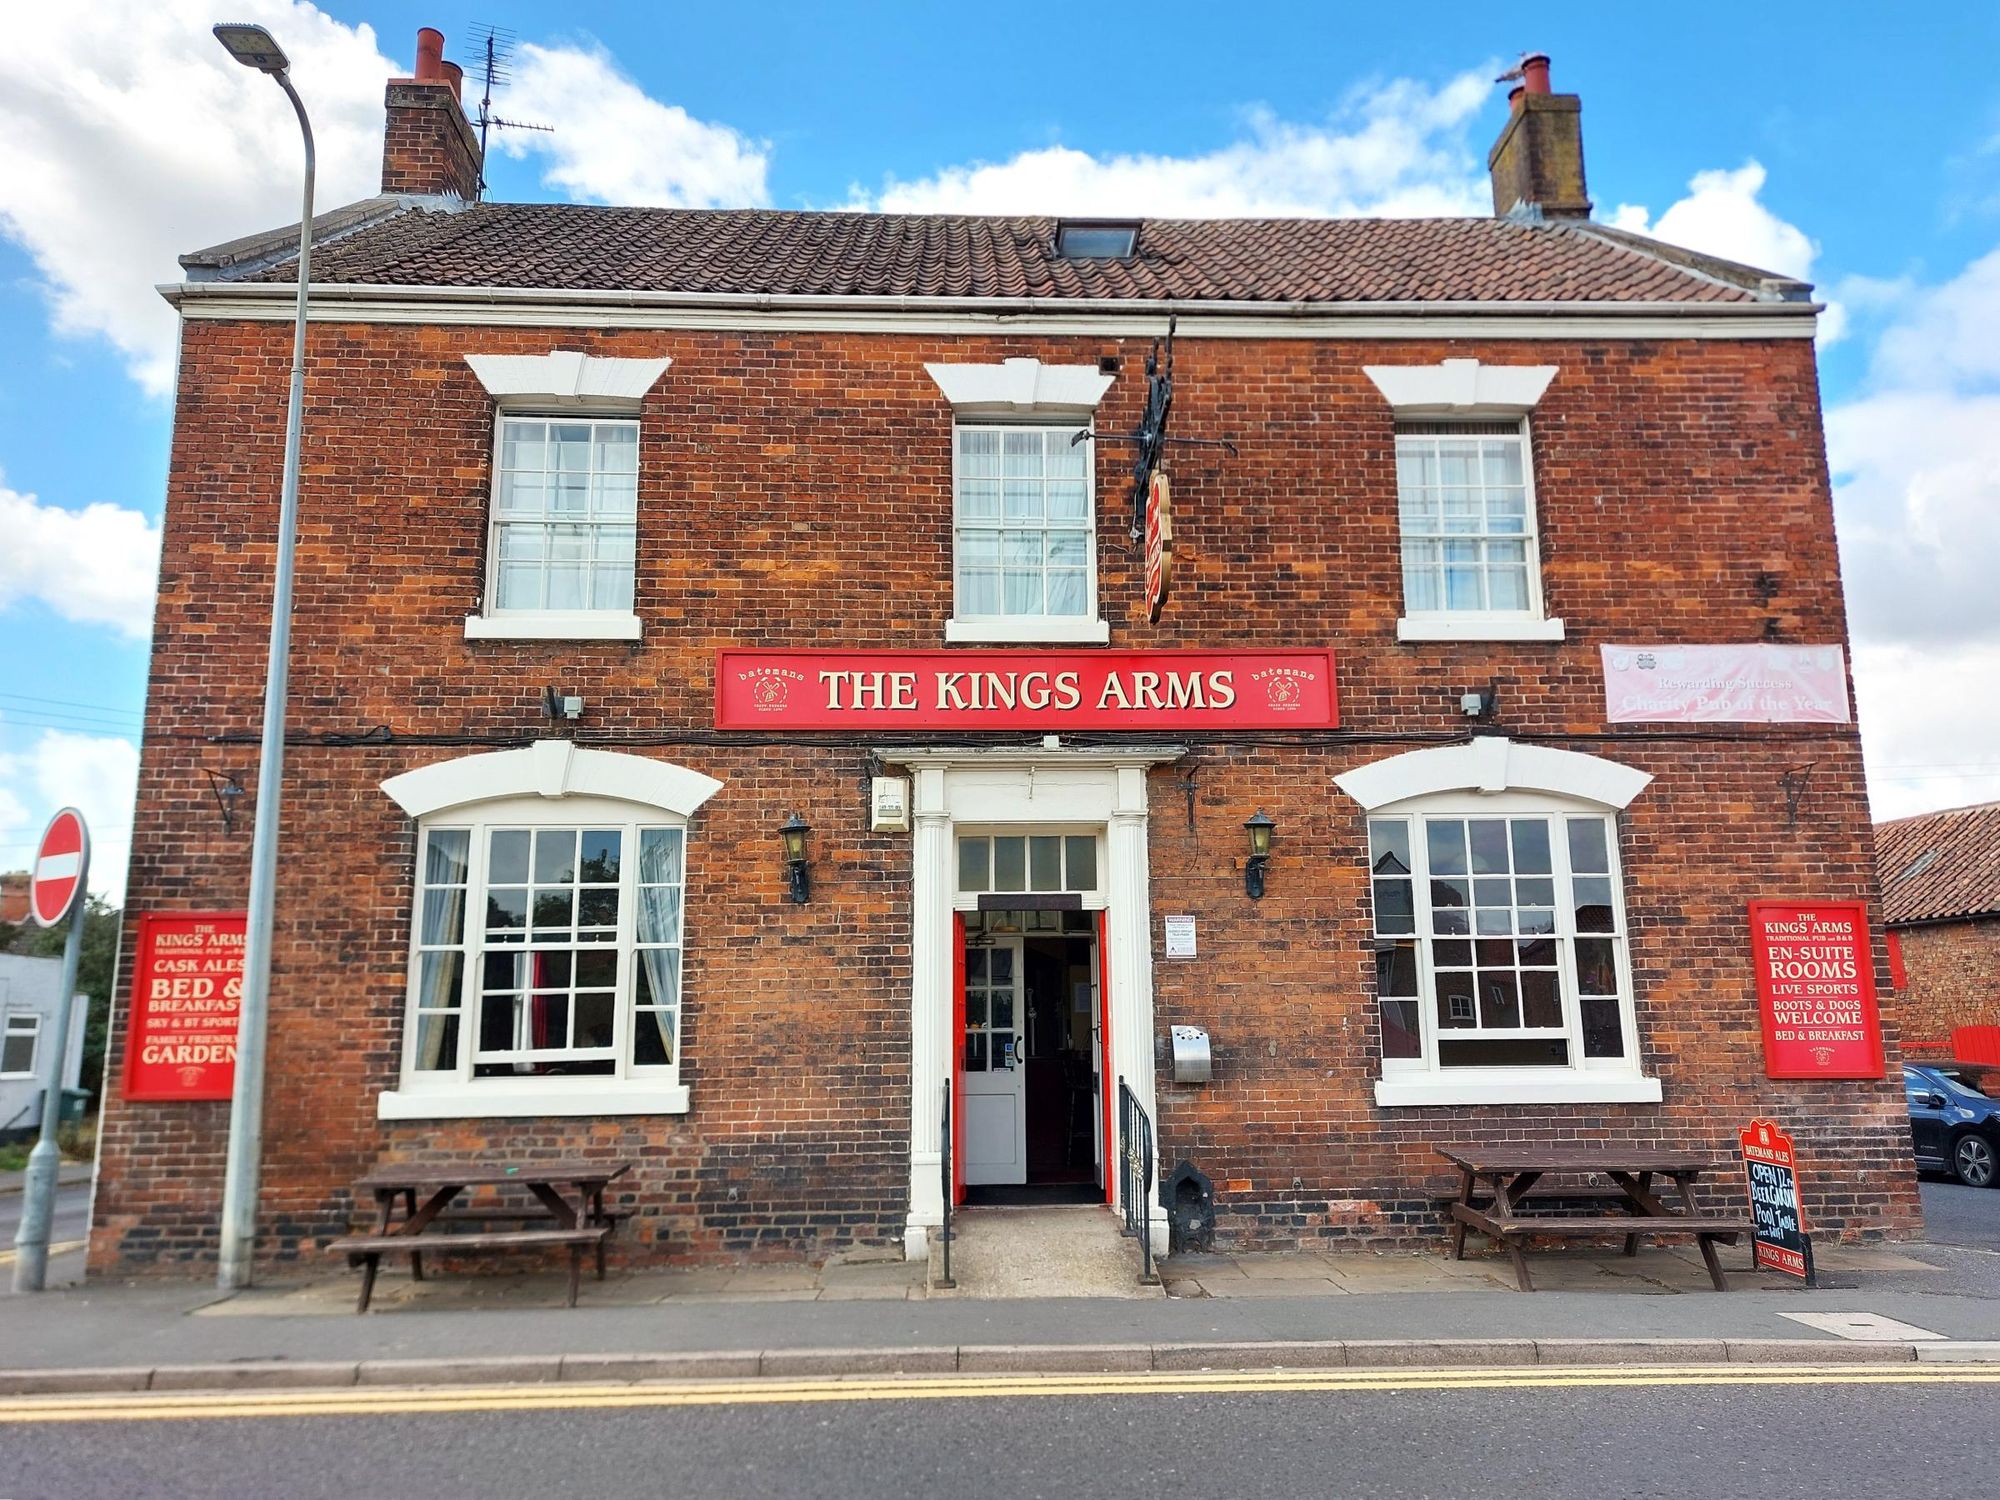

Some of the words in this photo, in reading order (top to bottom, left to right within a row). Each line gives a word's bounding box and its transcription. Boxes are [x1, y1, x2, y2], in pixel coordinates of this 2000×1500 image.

[738, 666, 804, 680] batemans
[1251, 667, 1315, 680] batemans
[819, 670, 918, 710] THE
[935, 671, 1081, 710] KINGS
[1096, 670, 1236, 710] ARMS
[1659, 677, 1735, 692] Rewarding
[1739, 677, 1792, 689] Success
[1696, 696, 1732, 710] Pub
[1739, 695, 1756, 710] of
[1760, 695, 1788, 710] the
[1793, 696, 1832, 710] Year
[1797, 913, 1817, 921] THE
[194, 925, 216, 934] THE
[1764, 922, 1807, 933] KINGS
[1812, 922, 1852, 933] ARMS
[156, 934, 203, 947] KINGS
[1768, 947, 1854, 960] EN-SUITE
[154, 960, 199, 973] CASK
[203, 960, 245, 973] ALES
[1769, 961, 1857, 979] ROOMS
[150, 978, 214, 999] BED
[223, 978, 242, 998] &
[1772, 984, 1803, 994] LIVE
[1807, 984, 1858, 994] SPORTS
[1773, 1000, 1813, 1010] BOOTS
[1816, 1001, 1825, 1010] &
[1829, 1000, 1861, 1010] DOGS
[202, 1017, 239, 1027] SPORT
[1774, 1012, 1863, 1024] WELCOME
[1775, 1031, 1795, 1040] BED
[1798, 1031, 1805, 1040] &
[1808, 1031, 1865, 1040] BREAKFAST
[142, 1045, 237, 1064] GARDEN
[1744, 1145, 1774, 1159] BATEMANS
[1775, 1150, 1789, 1162] ALES
[1753, 1164, 1778, 1186] OPEN
[1758, 1246, 1780, 1262] KINGS
[1782, 1253, 1804, 1270] ARMS
